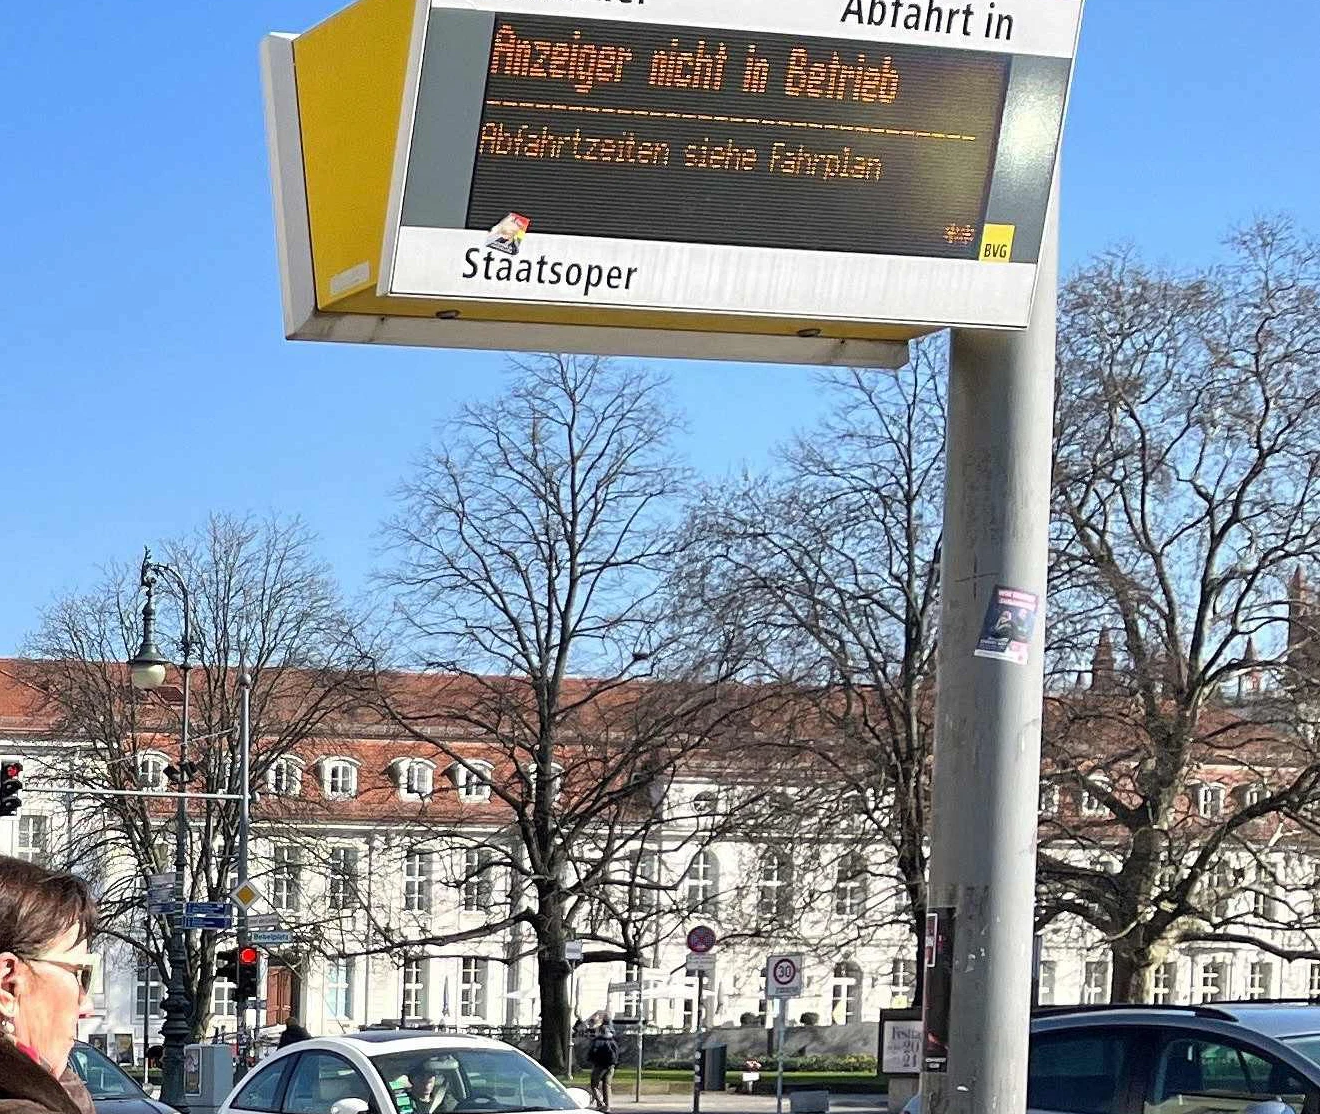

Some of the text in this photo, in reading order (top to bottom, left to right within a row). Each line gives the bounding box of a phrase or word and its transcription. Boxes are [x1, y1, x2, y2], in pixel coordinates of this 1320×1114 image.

[840, 0, 1014, 41] Abfahrt in
[490, 24, 901, 104] Anzeiger nicht in Betrieb
[479, 122, 883, 182] Abfahrtzeiten siehe Fahrplan
[462, 247, 638, 297] Staatsoper
[984, 243, 1008, 258] BVG
[778, 964, 792, 978] 30
